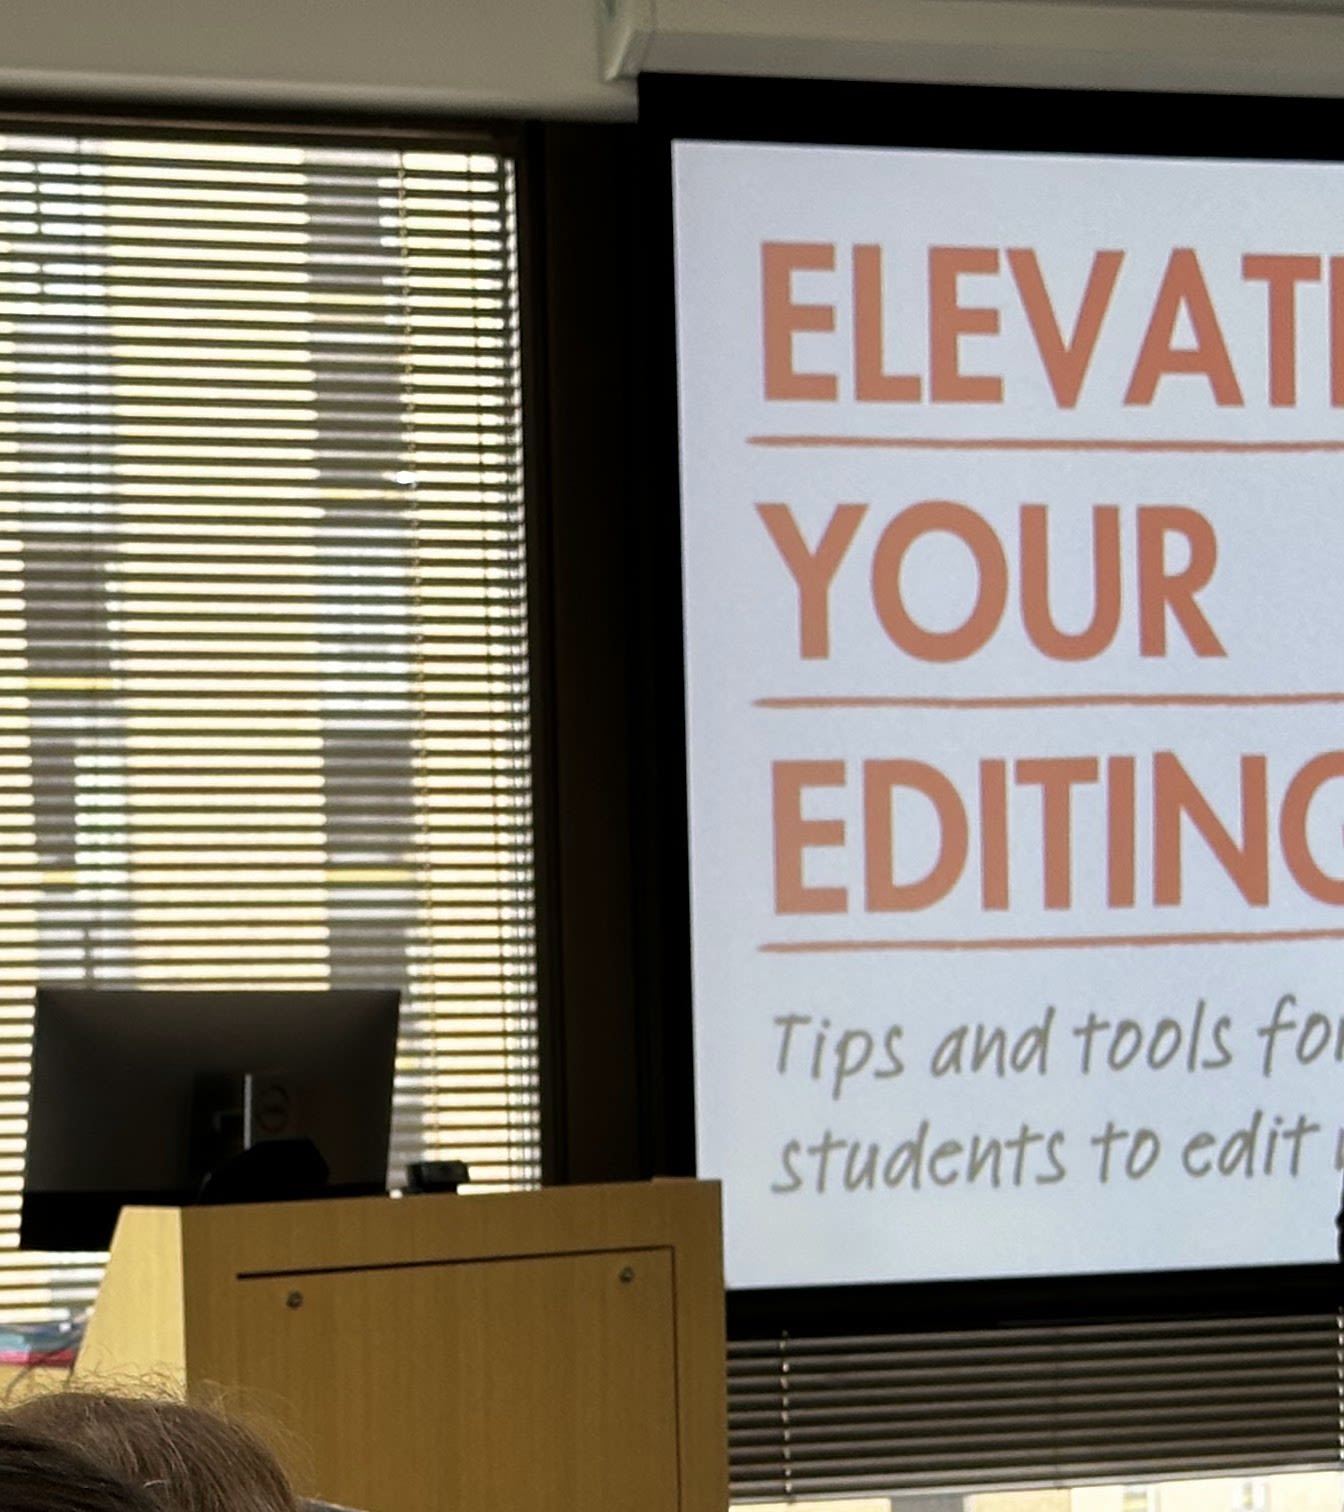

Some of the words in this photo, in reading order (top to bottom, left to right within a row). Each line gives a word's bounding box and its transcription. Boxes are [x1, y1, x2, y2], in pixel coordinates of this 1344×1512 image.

[755, 500, 1229, 663] YOUR
[772, 1012, 905, 1100] Tips
[931, 1005, 1056, 1077] and
[1072, 999, 1232, 1074] tools
[771, 1117, 1066, 1195] students
[1090, 1116, 1159, 1182] to
[1182, 1110, 1321, 1178] edit
